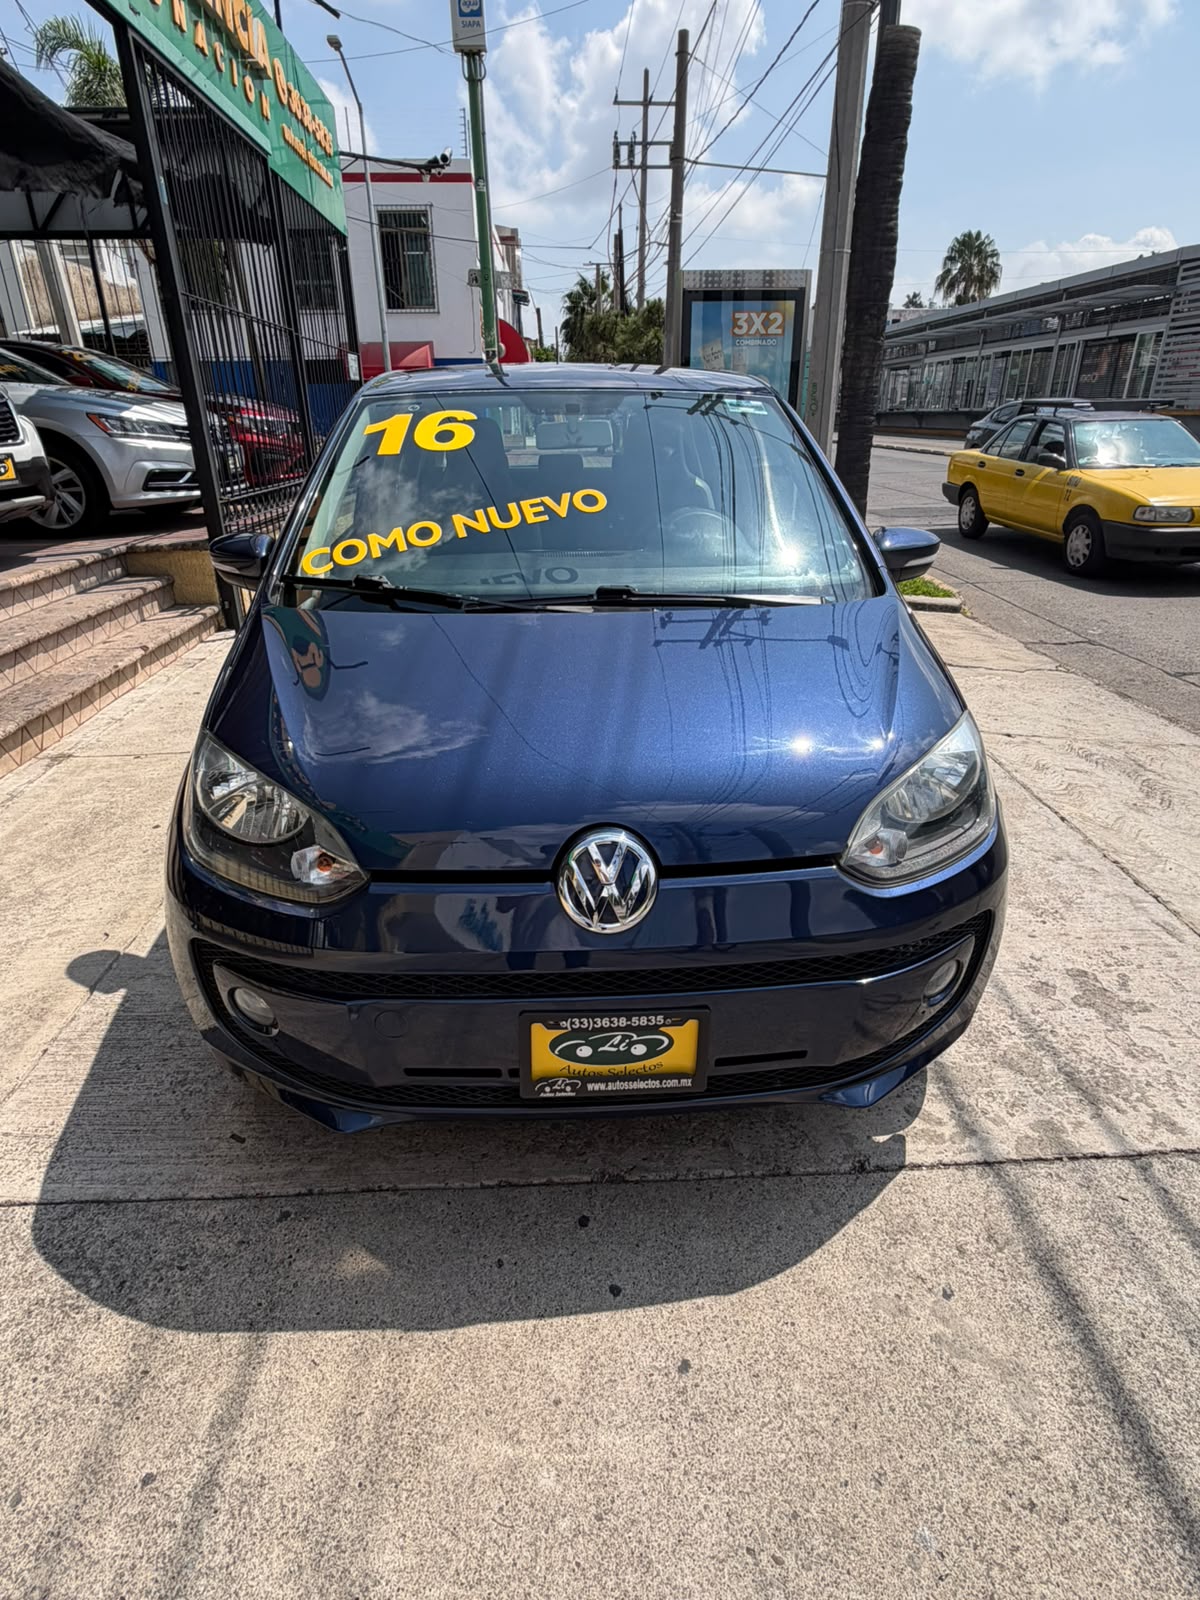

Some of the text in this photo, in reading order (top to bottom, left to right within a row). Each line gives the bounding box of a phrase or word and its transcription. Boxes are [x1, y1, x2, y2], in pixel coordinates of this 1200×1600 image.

[461, 20, 481, 28] SIAPA
[732, 311, 784, 335] 3X2
[735, 338, 777, 346] COMBINADO
[364, 410, 478, 456] 16
[301, 489, 607, 575] COMO NUEVO
[567, 1015, 665, 1030] (33)3638-5835
[559, 1061, 664, 1078] Autos Selectos
[587, 1078, 693, 1092] www.autosselectos.com.mx
